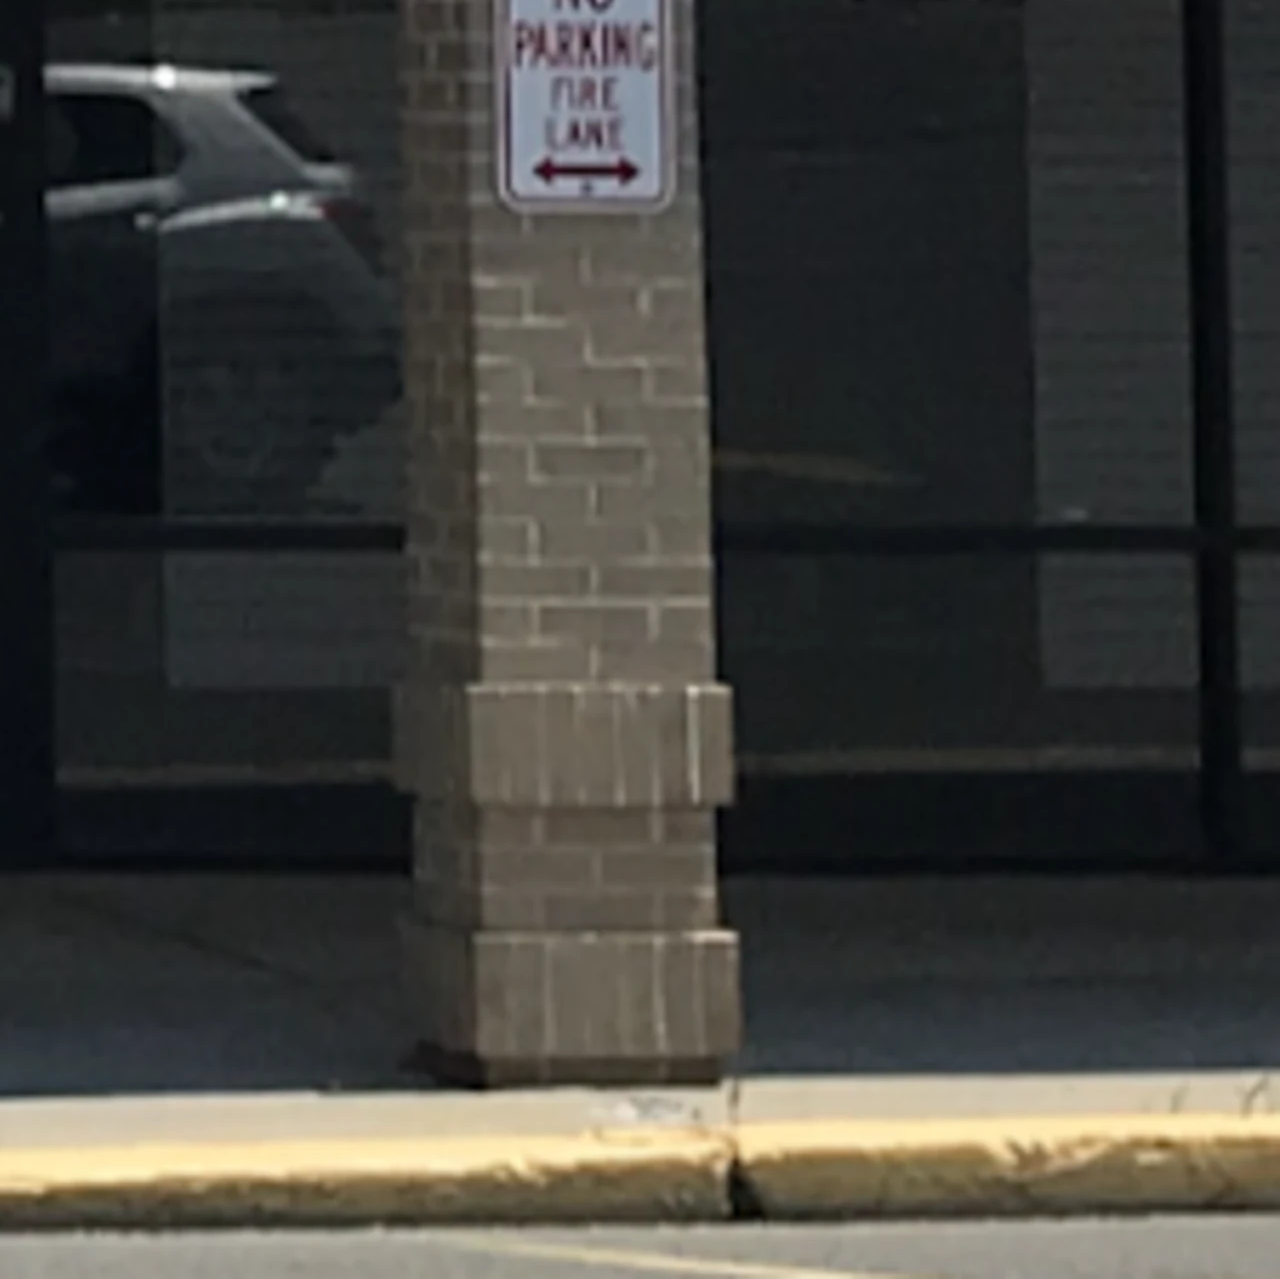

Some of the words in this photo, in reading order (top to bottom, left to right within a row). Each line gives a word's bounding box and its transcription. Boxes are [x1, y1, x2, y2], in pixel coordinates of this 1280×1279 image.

[513, 22, 657, 72] PARKING
[551, 76, 620, 112] FIRE
[544, 118, 624, 151] LANE
